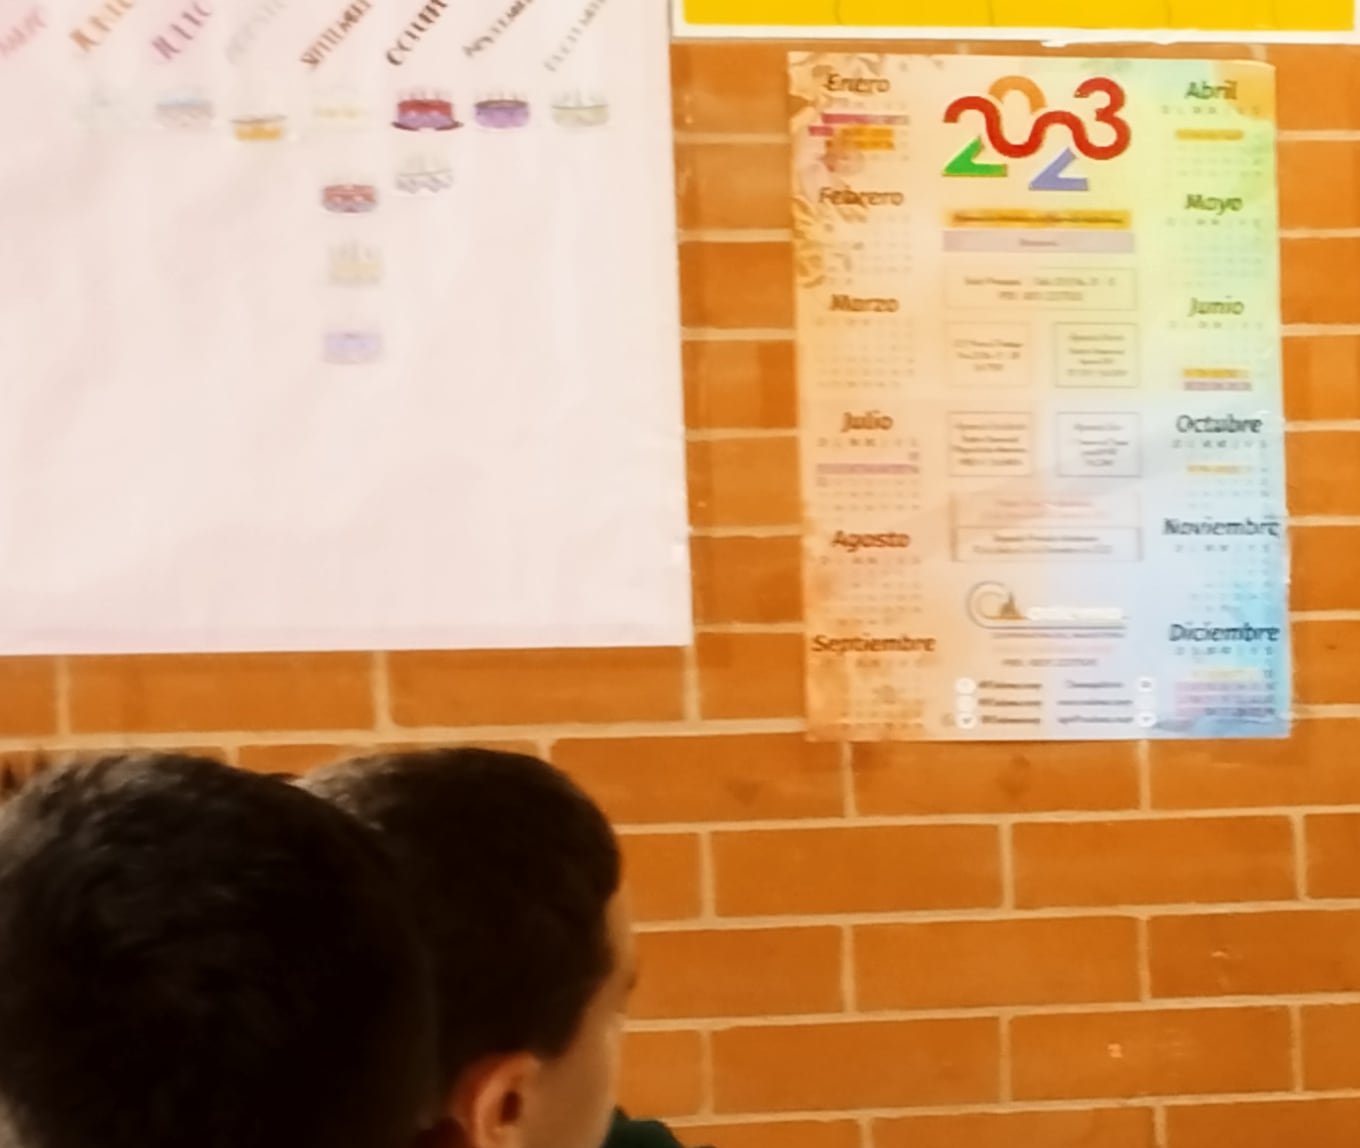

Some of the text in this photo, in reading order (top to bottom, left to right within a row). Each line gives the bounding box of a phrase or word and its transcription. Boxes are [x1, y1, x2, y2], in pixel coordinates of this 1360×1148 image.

[824, 74, 891, 93] Enero
[1185, 80, 1239, 101] Abril
[943, 75, 1131, 192] 2023
[818, 186, 905, 208] Febrero
[1185, 194, 1244, 216] Mayo
[829, 293, 900, 313] Marzo
[1189, 298, 1245, 317] Junio
[841, 410, 894, 432] Julio
[1176, 414, 1263, 434] Octubre
[1163, 516, 1280, 537] Noviembre
[830, 530, 910, 552] Agosto
[1169, 621, 1280, 643] Diciembre
[811, 632, 936, 656] Septiembre
